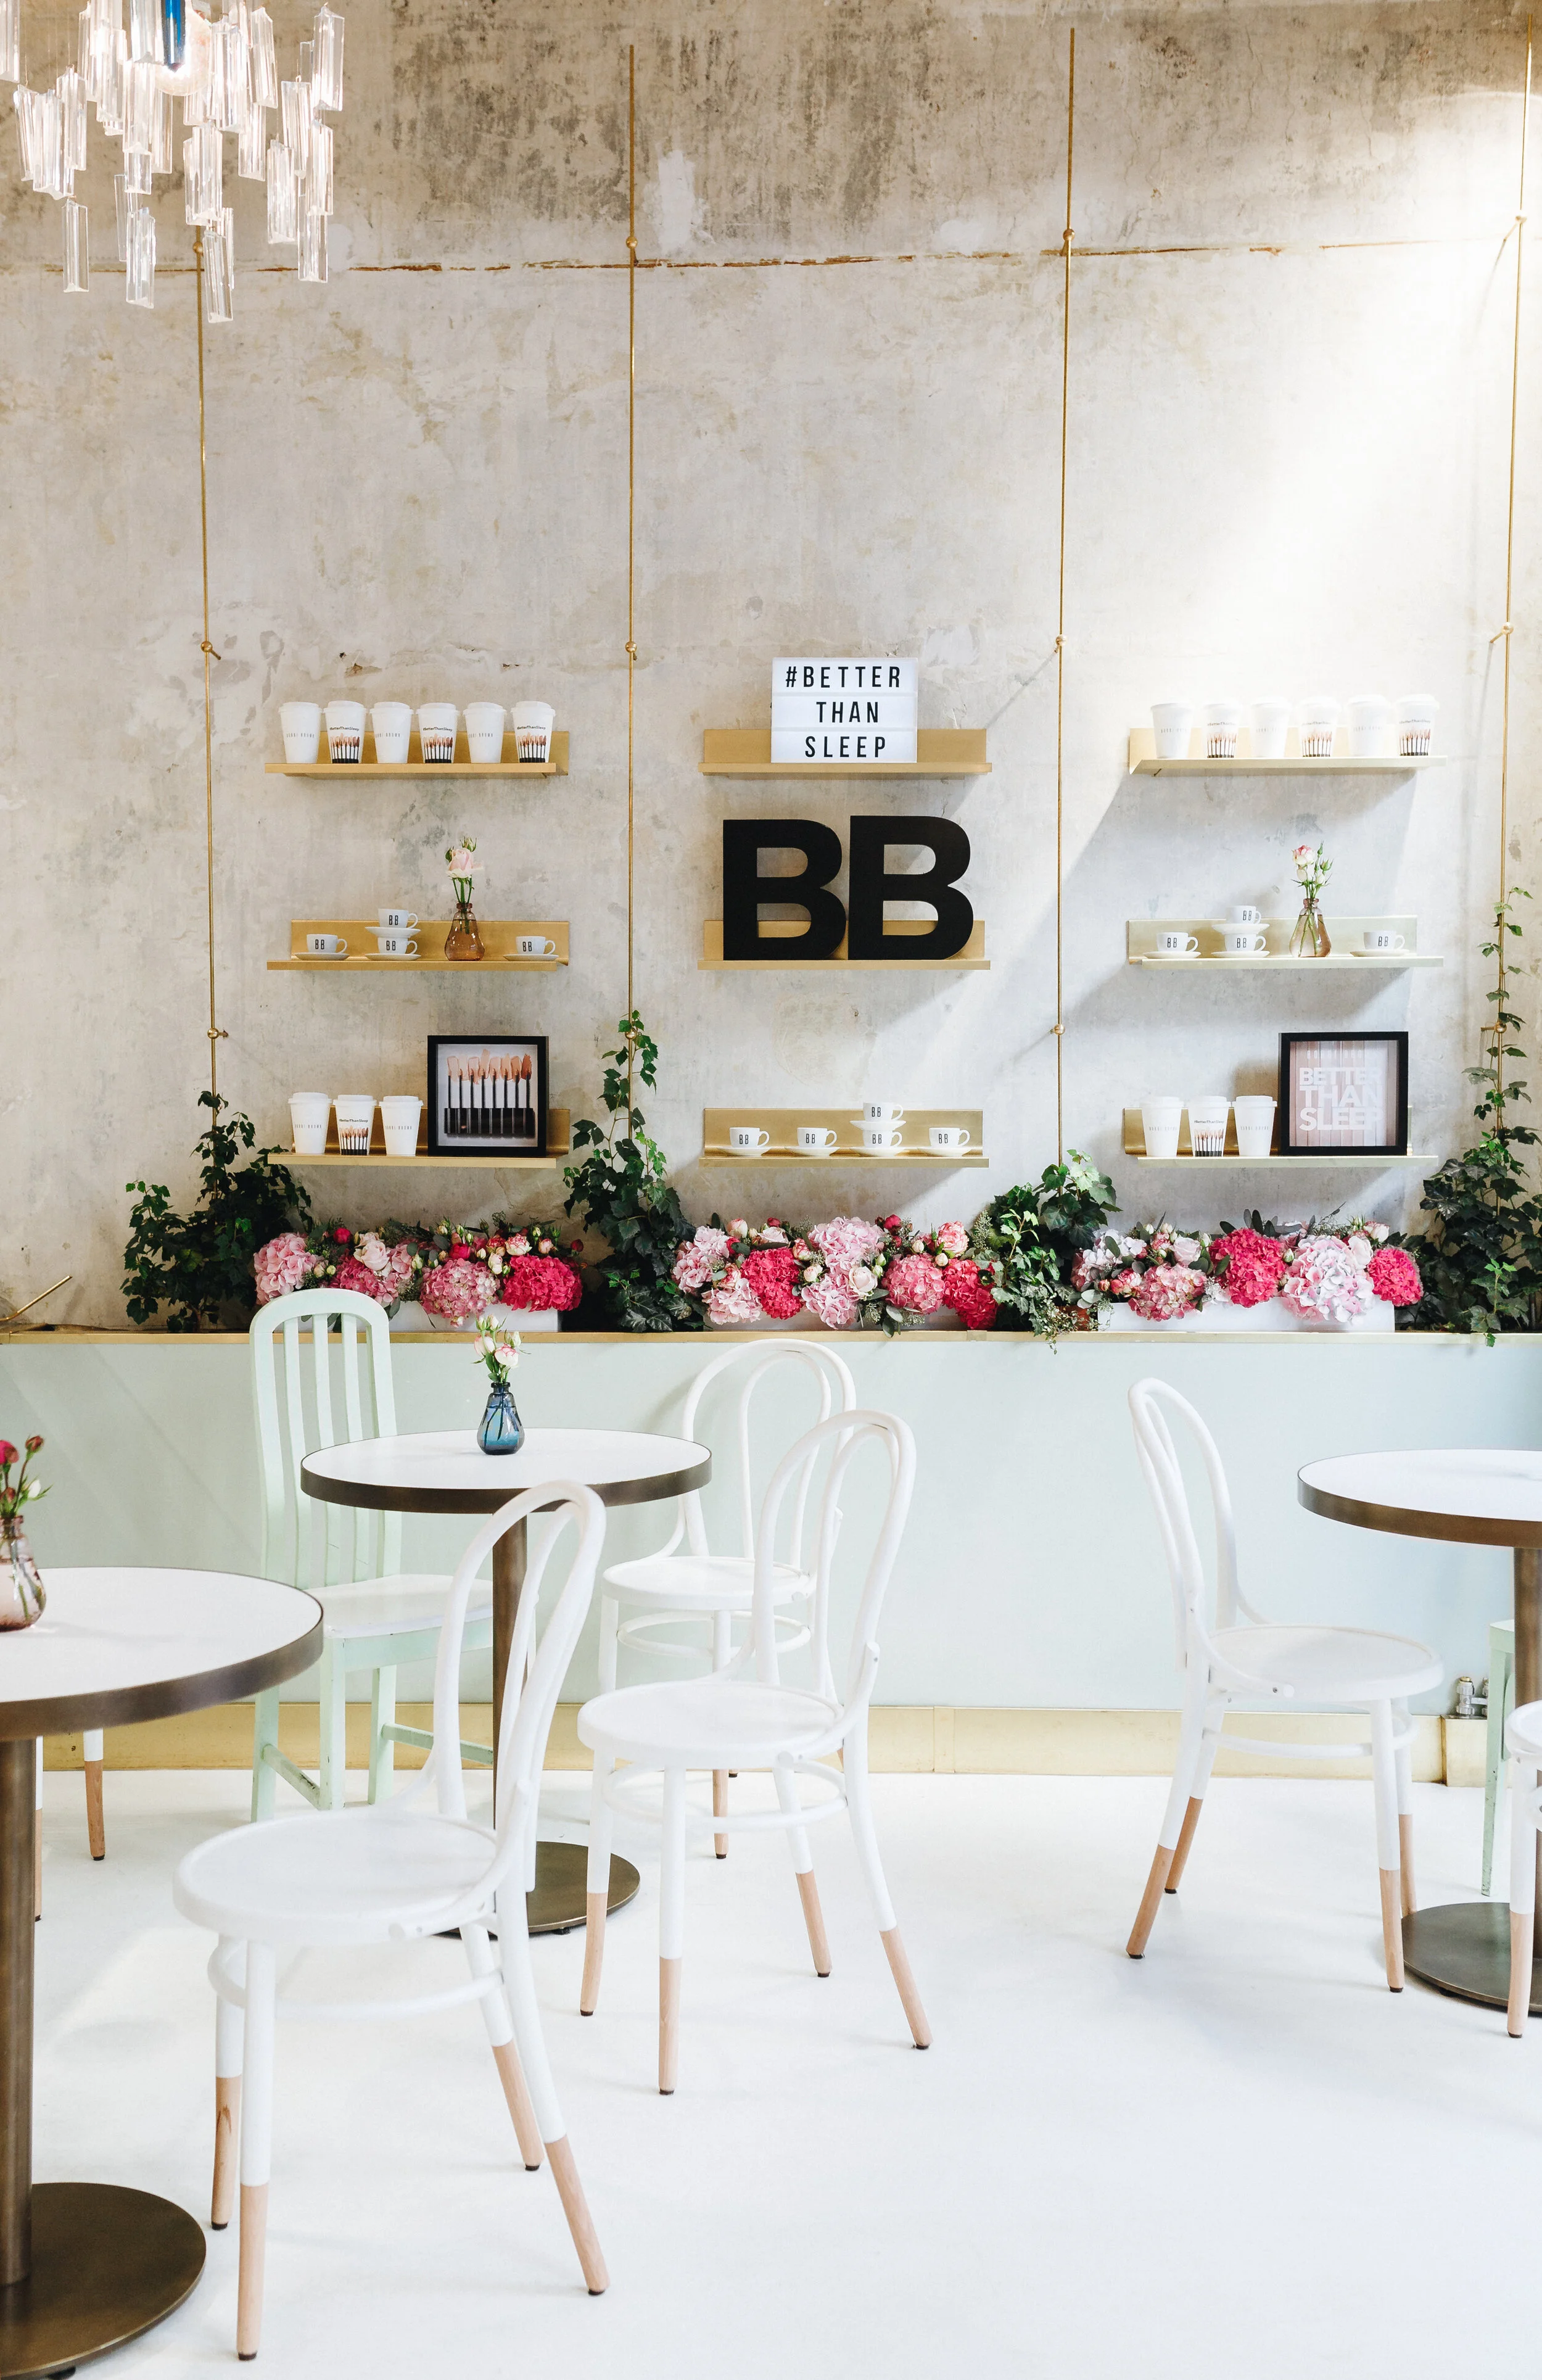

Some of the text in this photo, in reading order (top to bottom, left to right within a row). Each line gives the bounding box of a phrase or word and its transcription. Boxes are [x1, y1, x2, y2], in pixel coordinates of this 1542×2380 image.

[785, 666, 900, 688] #BETTER
[816, 701, 878, 723] THAN
[805, 735, 885, 758] SLEEP
[723, 815, 974, 961] BB
[389, 915, 398, 926] BB
[1242, 910, 1252, 921] BB
[315, 939, 325, 950] BB
[386, 940, 396, 951] BB
[522, 941, 532, 952] BB
[1167, 937, 1177, 948] BB
[1237, 938, 1247, 948] BB
[1378, 936, 1388, 947] BB
[1299, 1067, 1383, 1085] BETTER
[1299, 1085, 1383, 1107] THAN
[871, 1106, 881, 1117] BB
[1299, 1107, 1384, 1131] SLEEP
[739, 1134, 749, 1145] BB
[806, 1133, 815, 1144] BB
[872, 1134, 882, 1144] BB
[938, 1133, 948, 1144] BB
